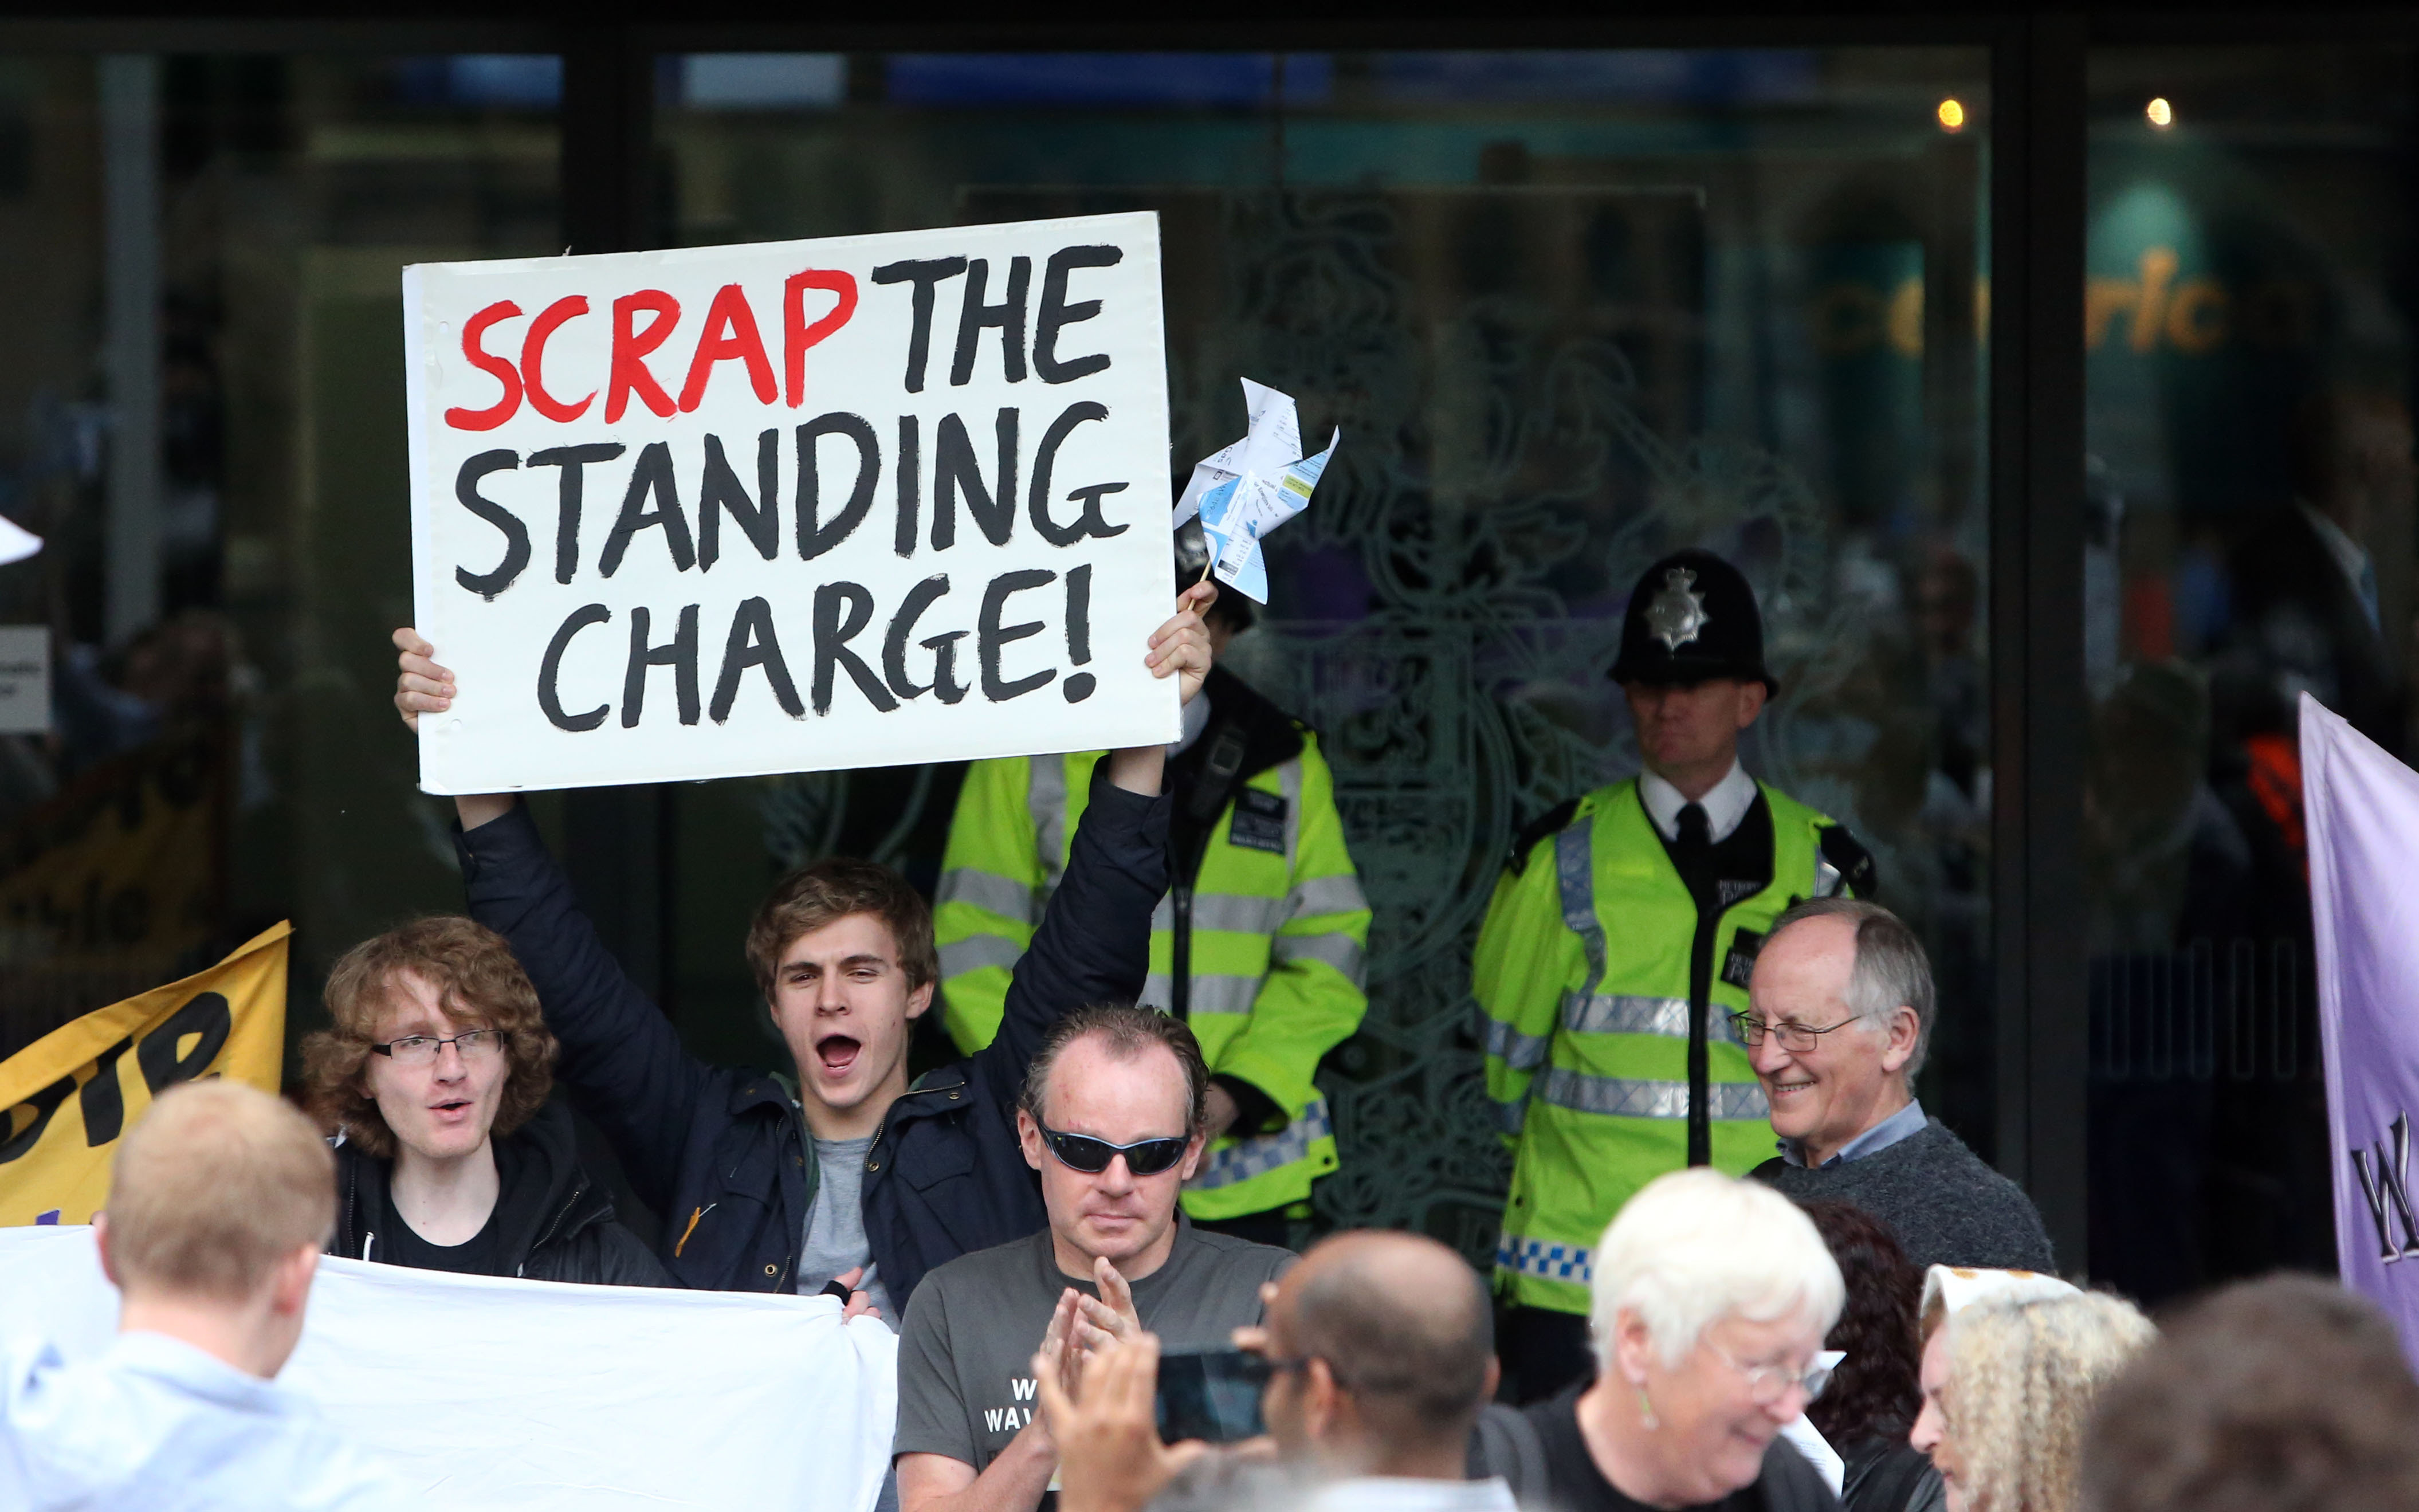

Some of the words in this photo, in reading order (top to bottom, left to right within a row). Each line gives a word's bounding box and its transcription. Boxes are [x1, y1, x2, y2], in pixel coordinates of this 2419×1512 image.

[445, 268, 859, 431] SCRAP
[871, 244, 1124, 394] THE
[455, 401, 1130, 600] STANDING
[537, 563, 1097, 732] CHARGE!
